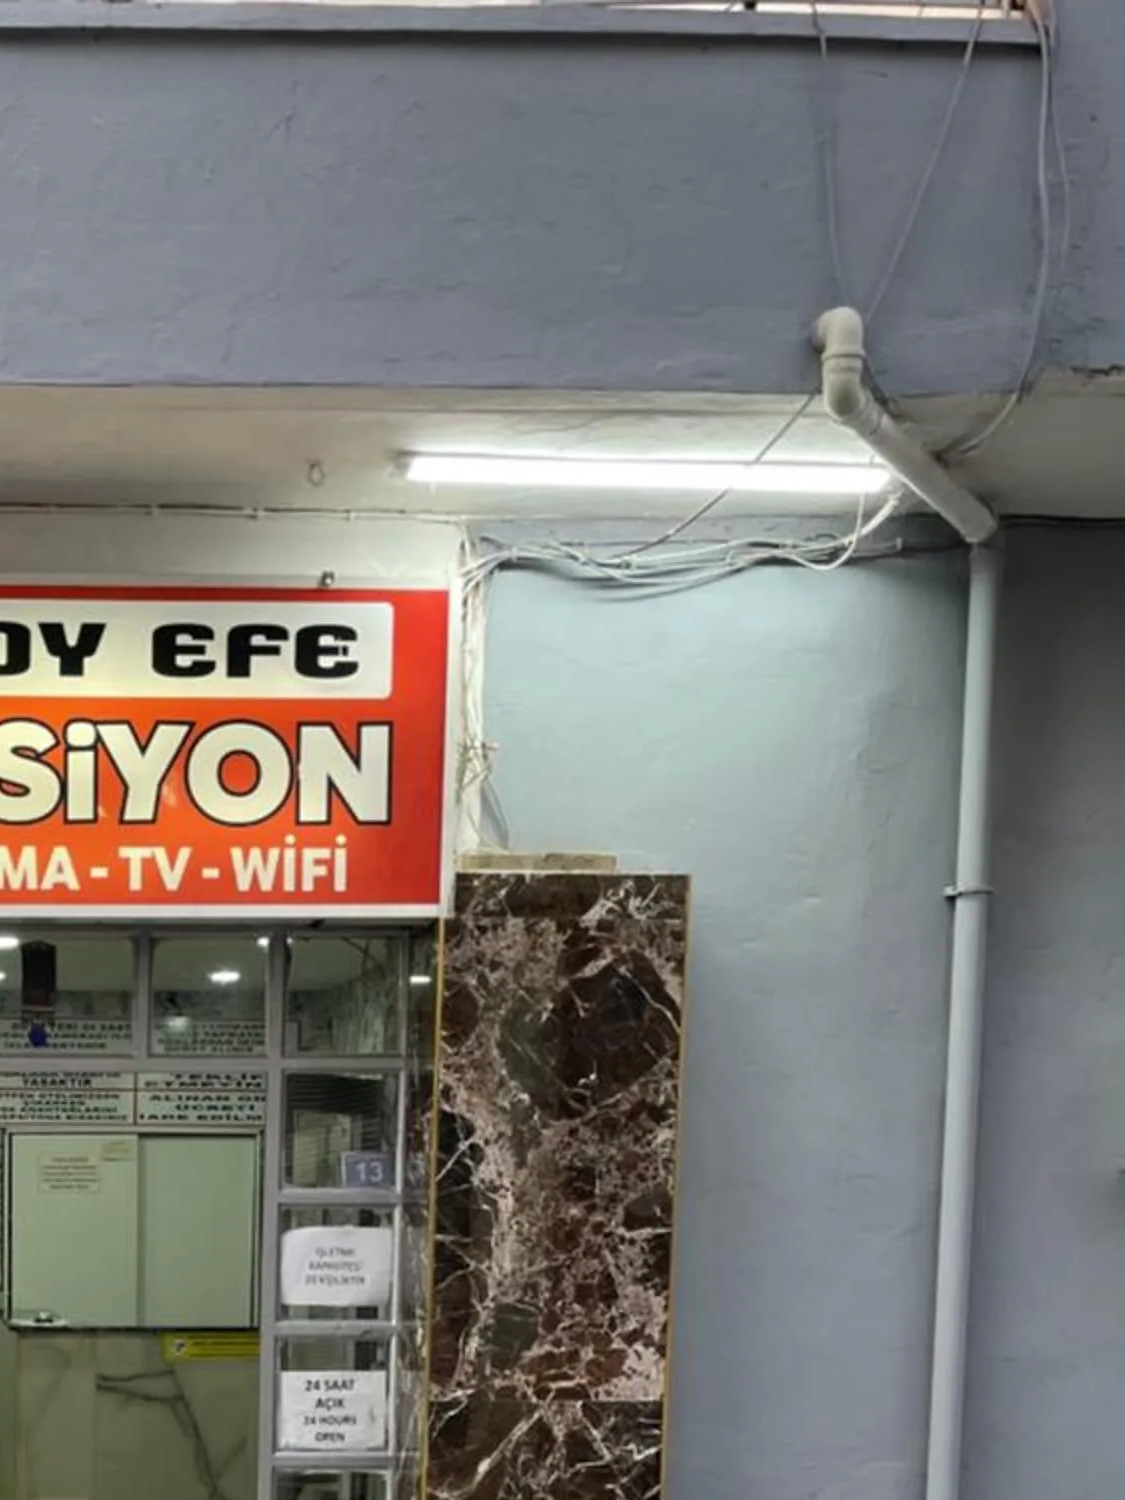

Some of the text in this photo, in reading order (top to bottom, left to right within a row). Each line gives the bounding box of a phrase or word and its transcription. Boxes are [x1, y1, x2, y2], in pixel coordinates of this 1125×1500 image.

[151, 623, 359, 680] EFE
[127, 846, 192, 892] TV
[356, 1161, 384, 1182] 13
[304, 1378, 355, 1392] 24 SAAT
[315, 1397, 345, 1412] AÇIK
[318, 1414, 357, 1427] HOURS
[315, 1431, 345, 1442] OPEN
